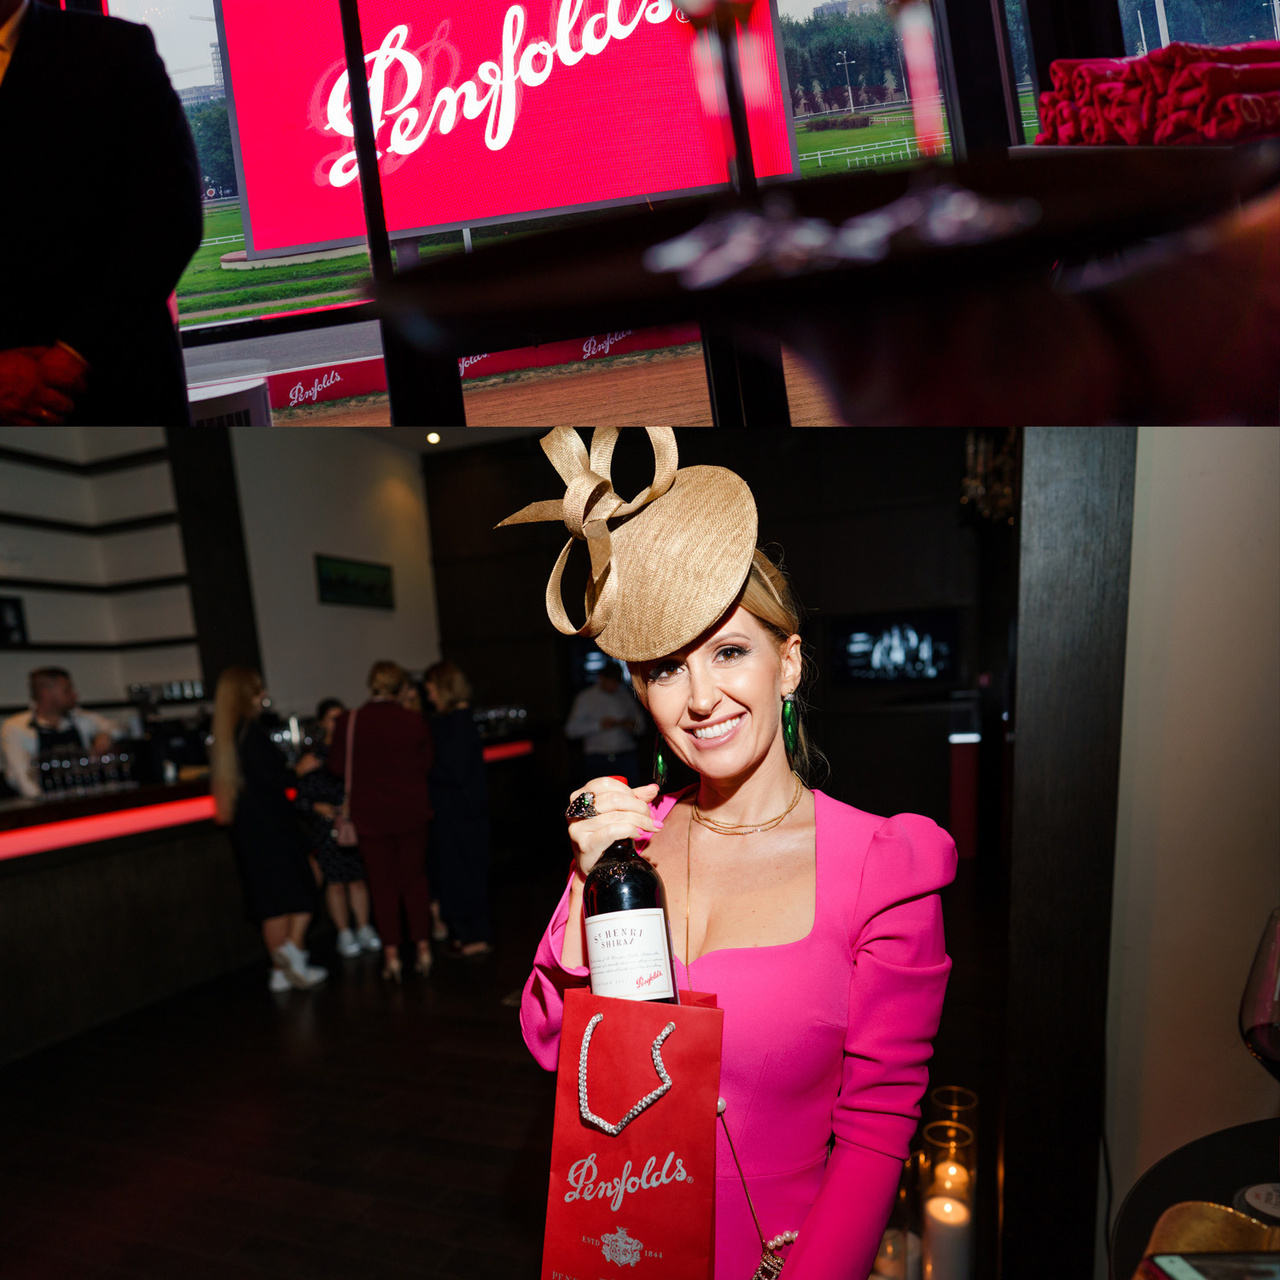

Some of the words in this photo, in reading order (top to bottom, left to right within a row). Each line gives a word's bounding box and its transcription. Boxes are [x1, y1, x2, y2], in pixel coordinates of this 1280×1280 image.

[289, 370, 342, 407] Penfolds
[564, 1151, 688, 1212] Penfolds
[582, 1235, 600, 1246] ESTD
[644, 1250, 663, 1258] 1844
